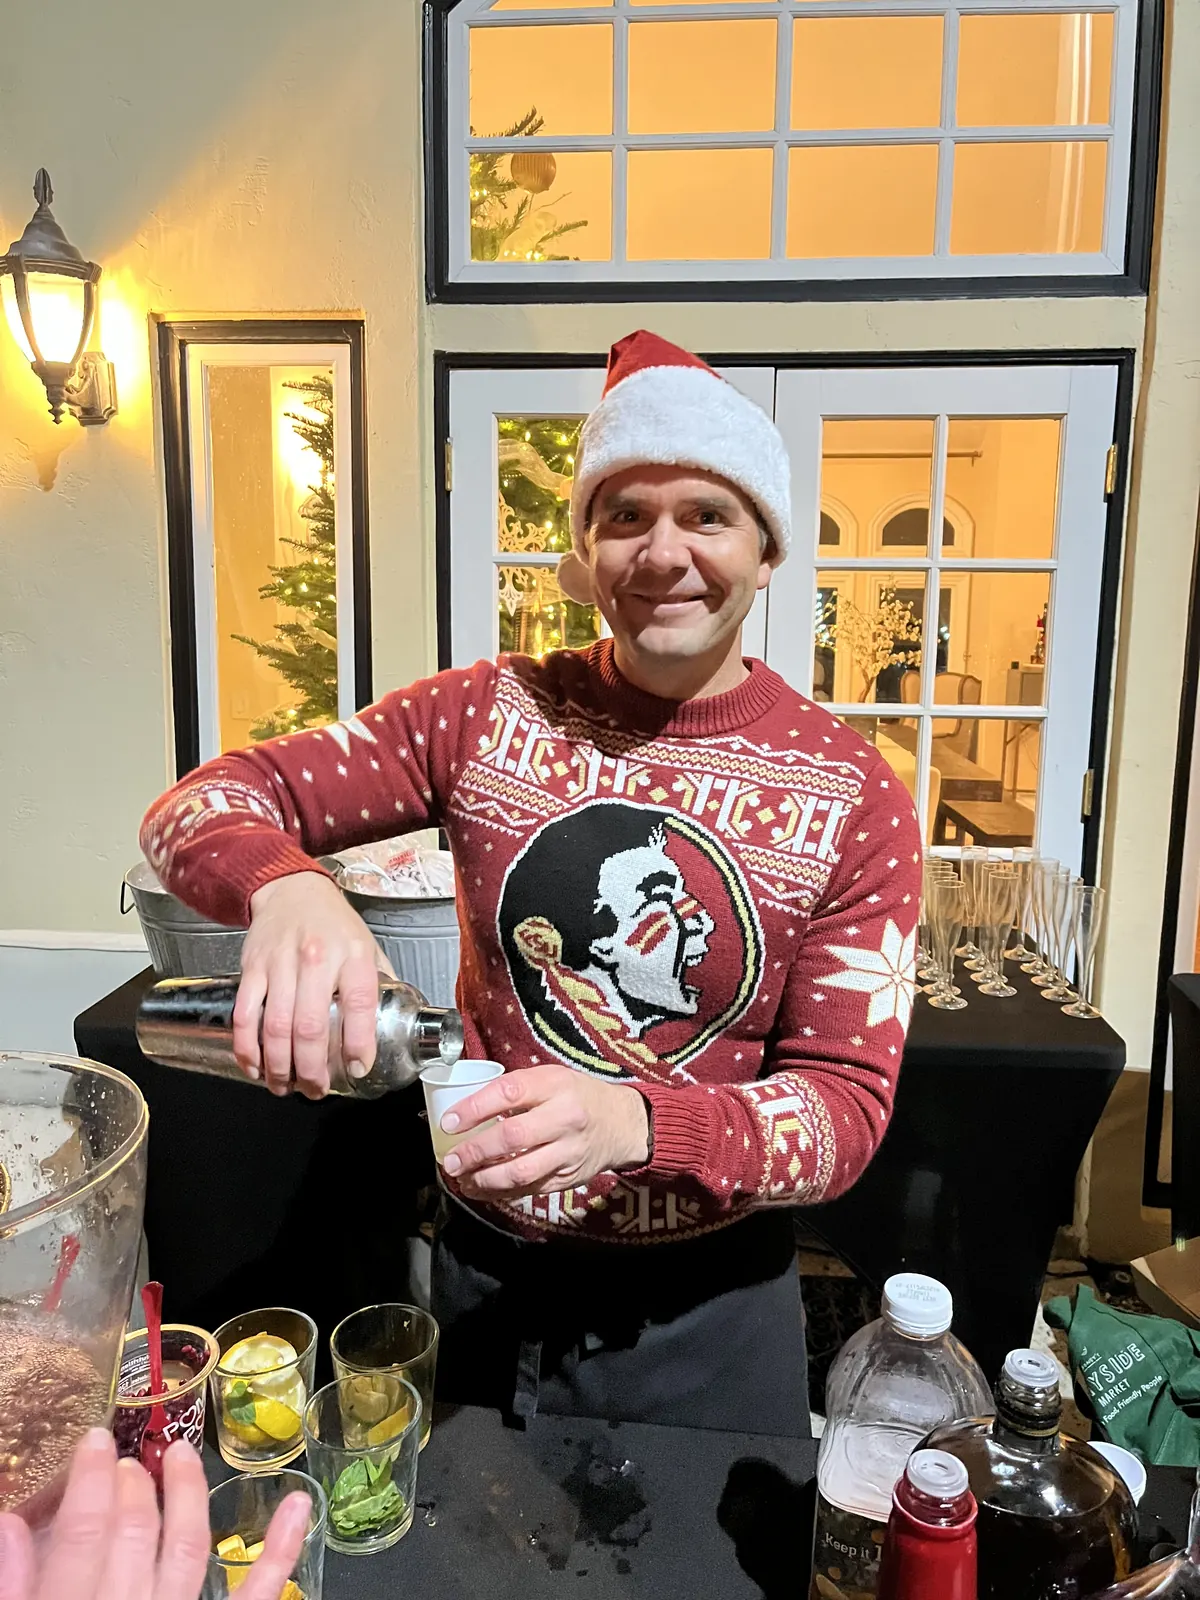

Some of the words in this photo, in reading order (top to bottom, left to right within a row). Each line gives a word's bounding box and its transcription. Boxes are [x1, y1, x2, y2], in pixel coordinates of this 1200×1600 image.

[1087, 1343, 1146, 1397] YSIDE
[1098, 1378, 1131, 1408] MARKET
[1117, 1389, 1143, 1410] Friendly
[1140, 1375, 1163, 1393] People
[825, 1532, 858, 1559] Keep
[860, 1546, 870, 1560] it
